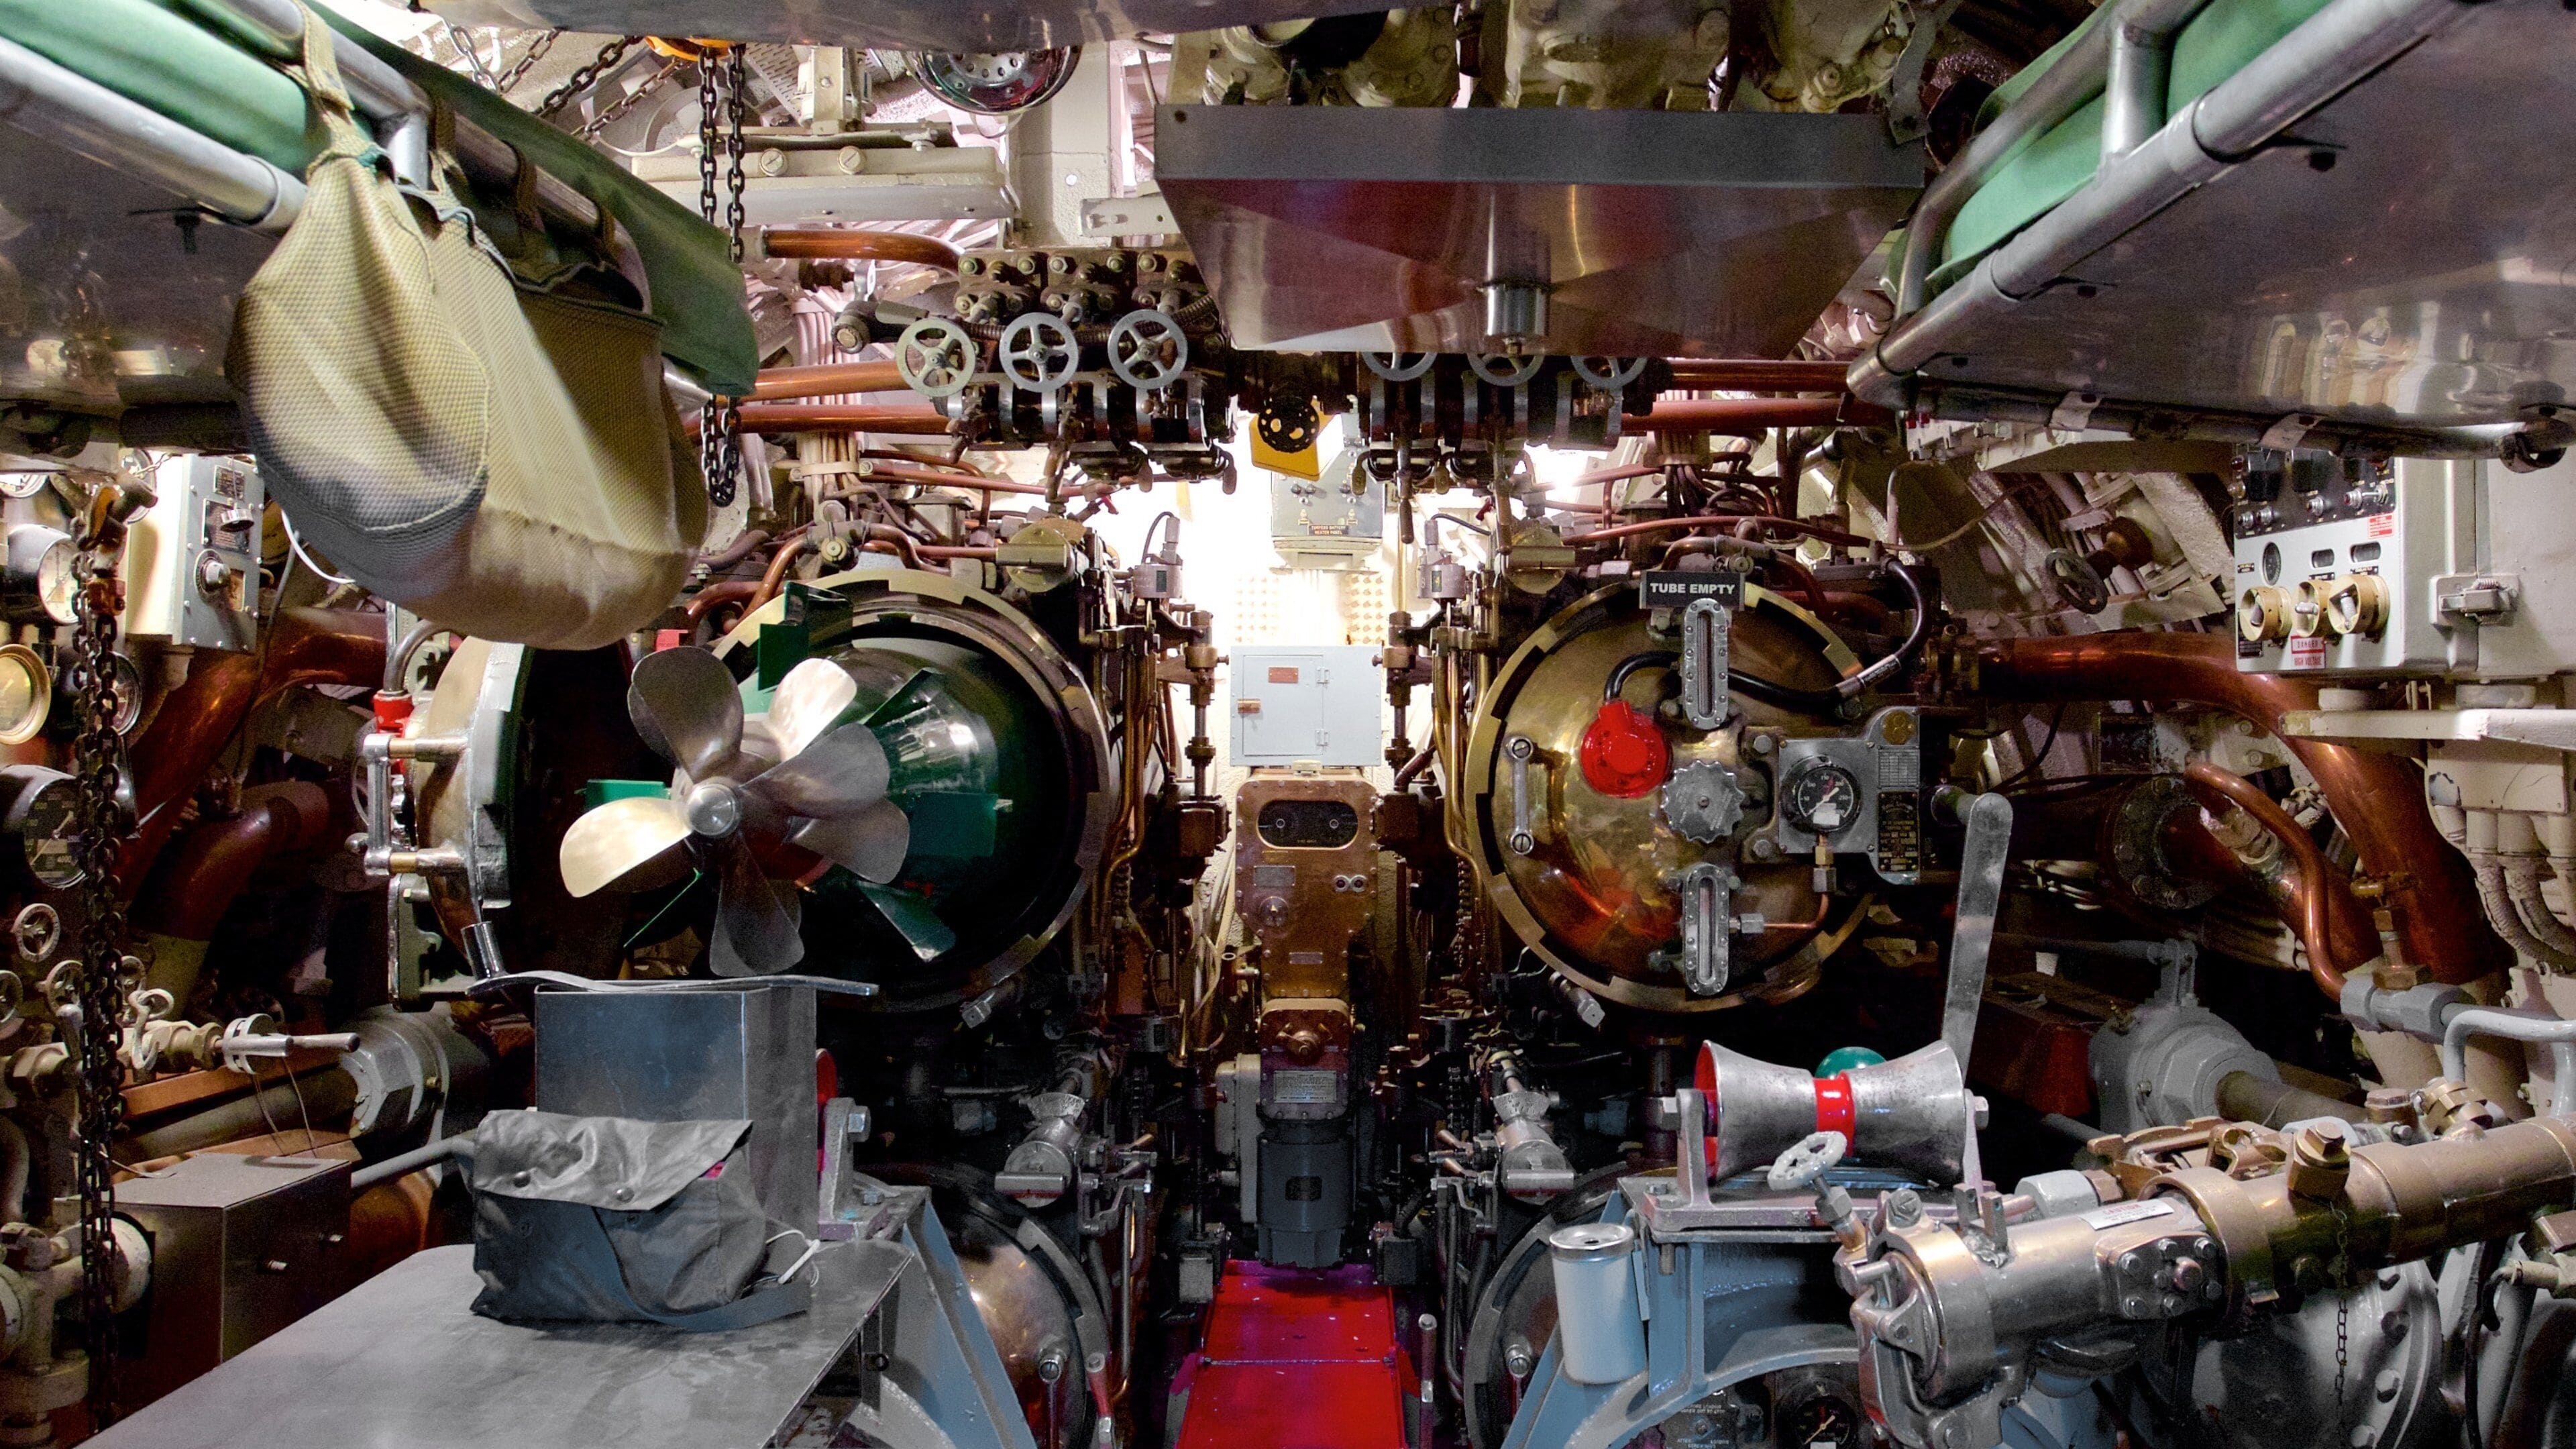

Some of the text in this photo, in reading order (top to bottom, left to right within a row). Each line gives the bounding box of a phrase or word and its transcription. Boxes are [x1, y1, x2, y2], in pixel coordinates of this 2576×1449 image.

[1650, 583, 1735, 594] TUBE EMPTY
[2297, 640, 2318, 648] DANGER
